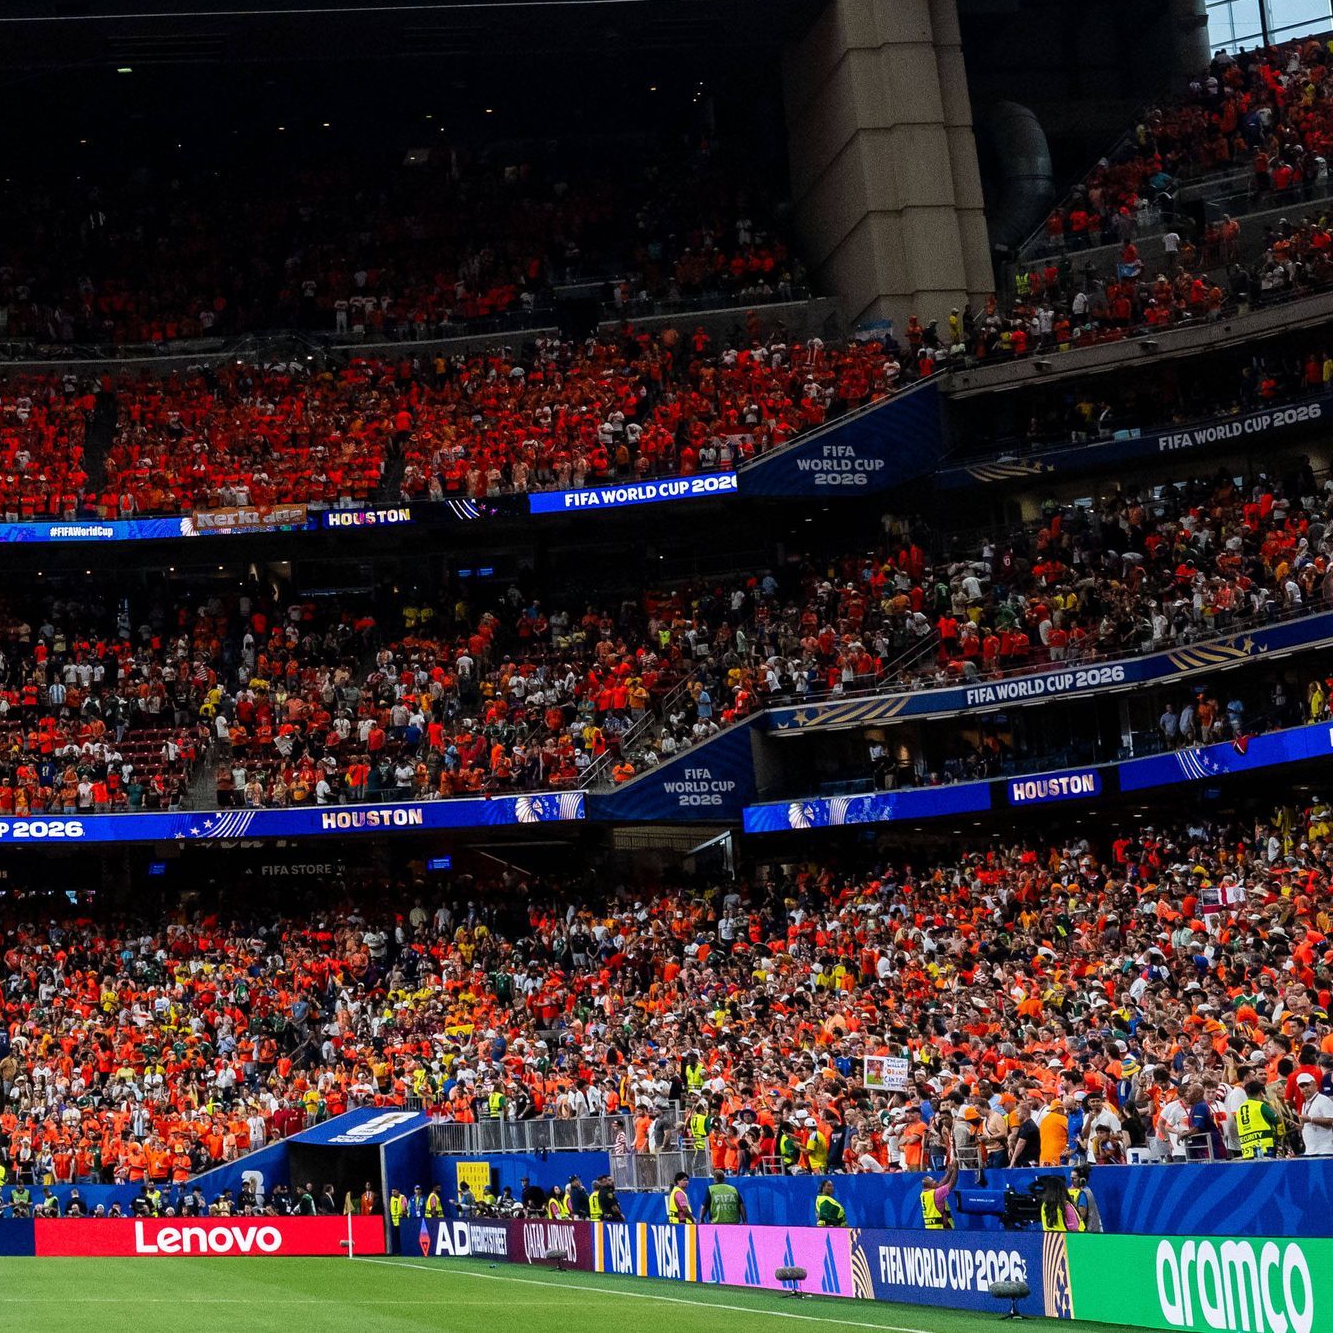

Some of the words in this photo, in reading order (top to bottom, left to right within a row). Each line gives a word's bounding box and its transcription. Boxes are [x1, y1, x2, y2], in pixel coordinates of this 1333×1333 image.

[1158, 434, 1192, 451] FIFA
[1193, 423, 1242, 444] WORLD
[1246, 417, 1271, 433] CUP
[1272, 403, 1321, 427] 2026
[822, 445, 856, 457] FIFA
[796, 459, 852, 471] WORLD
[853, 459, 885, 471] CUP
[814, 472, 868, 485] 2026
[565, 493, 599, 506] FIFA
[602, 486, 660, 503] WORLD
[660, 482, 689, 496] CUP
[329, 507, 410, 525] HOUSTON
[50, 527, 113, 537] #FIFAWorldCup
[966, 687, 996, 706] FIFA
[996, 679, 1045, 702] WORLD
[1046, 674, 1074, 692] CUP
[1075, 666, 1125, 689] 2026
[684, 769, 712, 780] FIFA
[663, 782, 709, 793] WORLD
[710, 781, 736, 792] CUP
[1013, 774, 1094, 800] HOUSTON
[678, 794, 723, 806] 2026
[322, 809, 422, 829] HOUSTON
[13, 822, 83, 837] 2026
[261, 866, 290, 876] FIFA
[292, 864, 331, 875] STORE
[714, 1194, 737, 1204] FIFA
[135, 1220, 283, 1254] Lenovo
[523, 1223, 547, 1264] QATAR
[607, 1223, 633, 1274] VISA
[651, 1224, 681, 1279] VISA
[878, 1245, 906, 1285] FIFA
[903, 1246, 947, 1289] WORLD
[948, 1248, 975, 1291] CUP
[974, 1249, 1025, 1292] 2026
[1155, 1239, 1314, 1333] aramco
